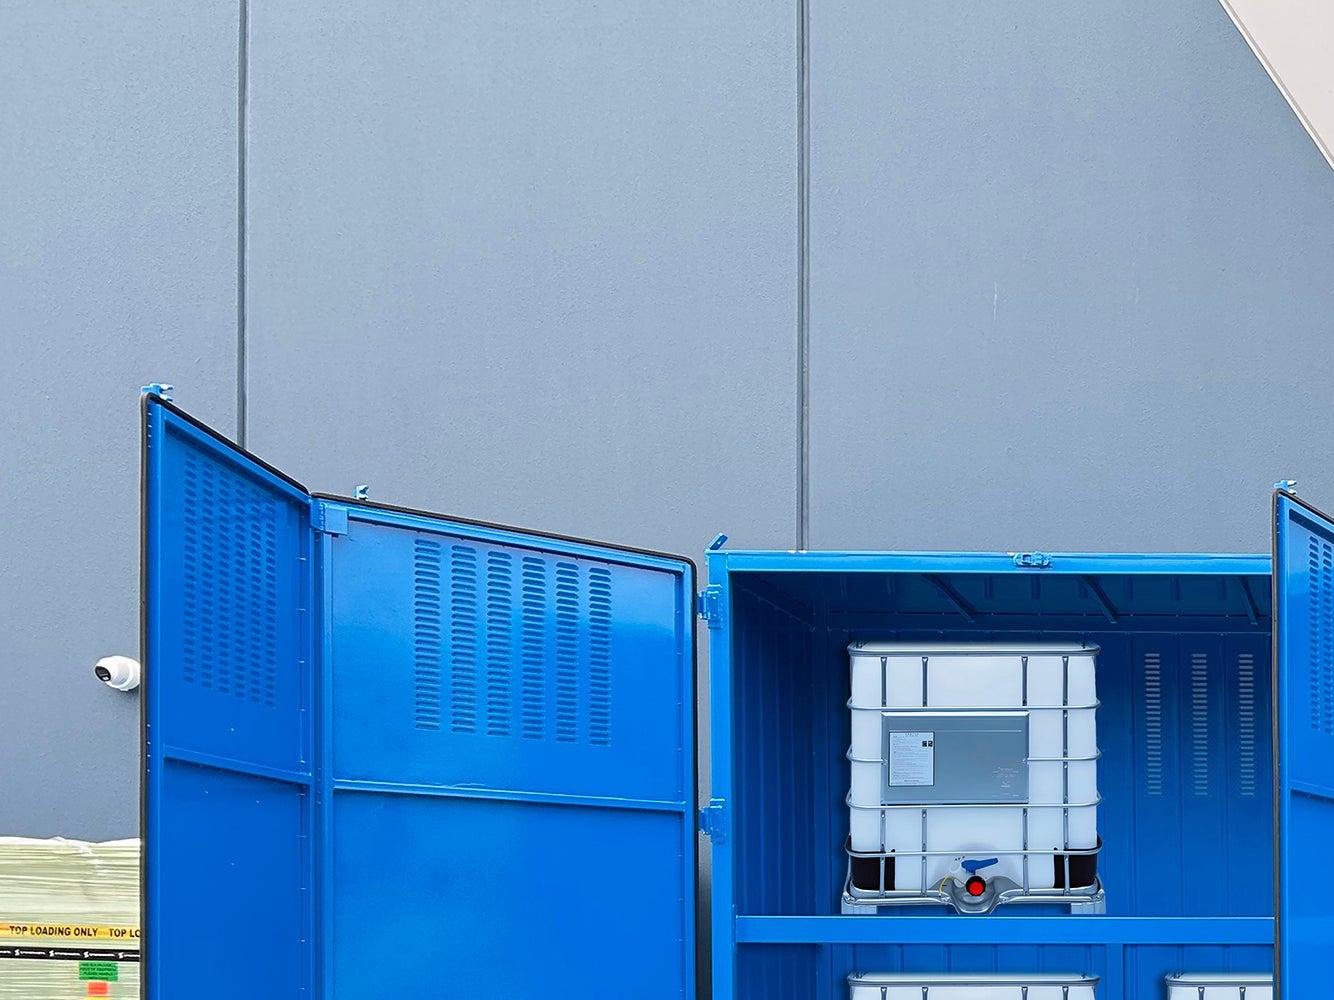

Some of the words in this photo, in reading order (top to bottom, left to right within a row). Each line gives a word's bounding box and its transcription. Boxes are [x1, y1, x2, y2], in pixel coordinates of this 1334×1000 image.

[10, 926, 27, 935] TOP
[30, 927, 71, 936] LOADING
[74, 927, 98, 937] ONLY
[109, 928, 127, 938] TOP
